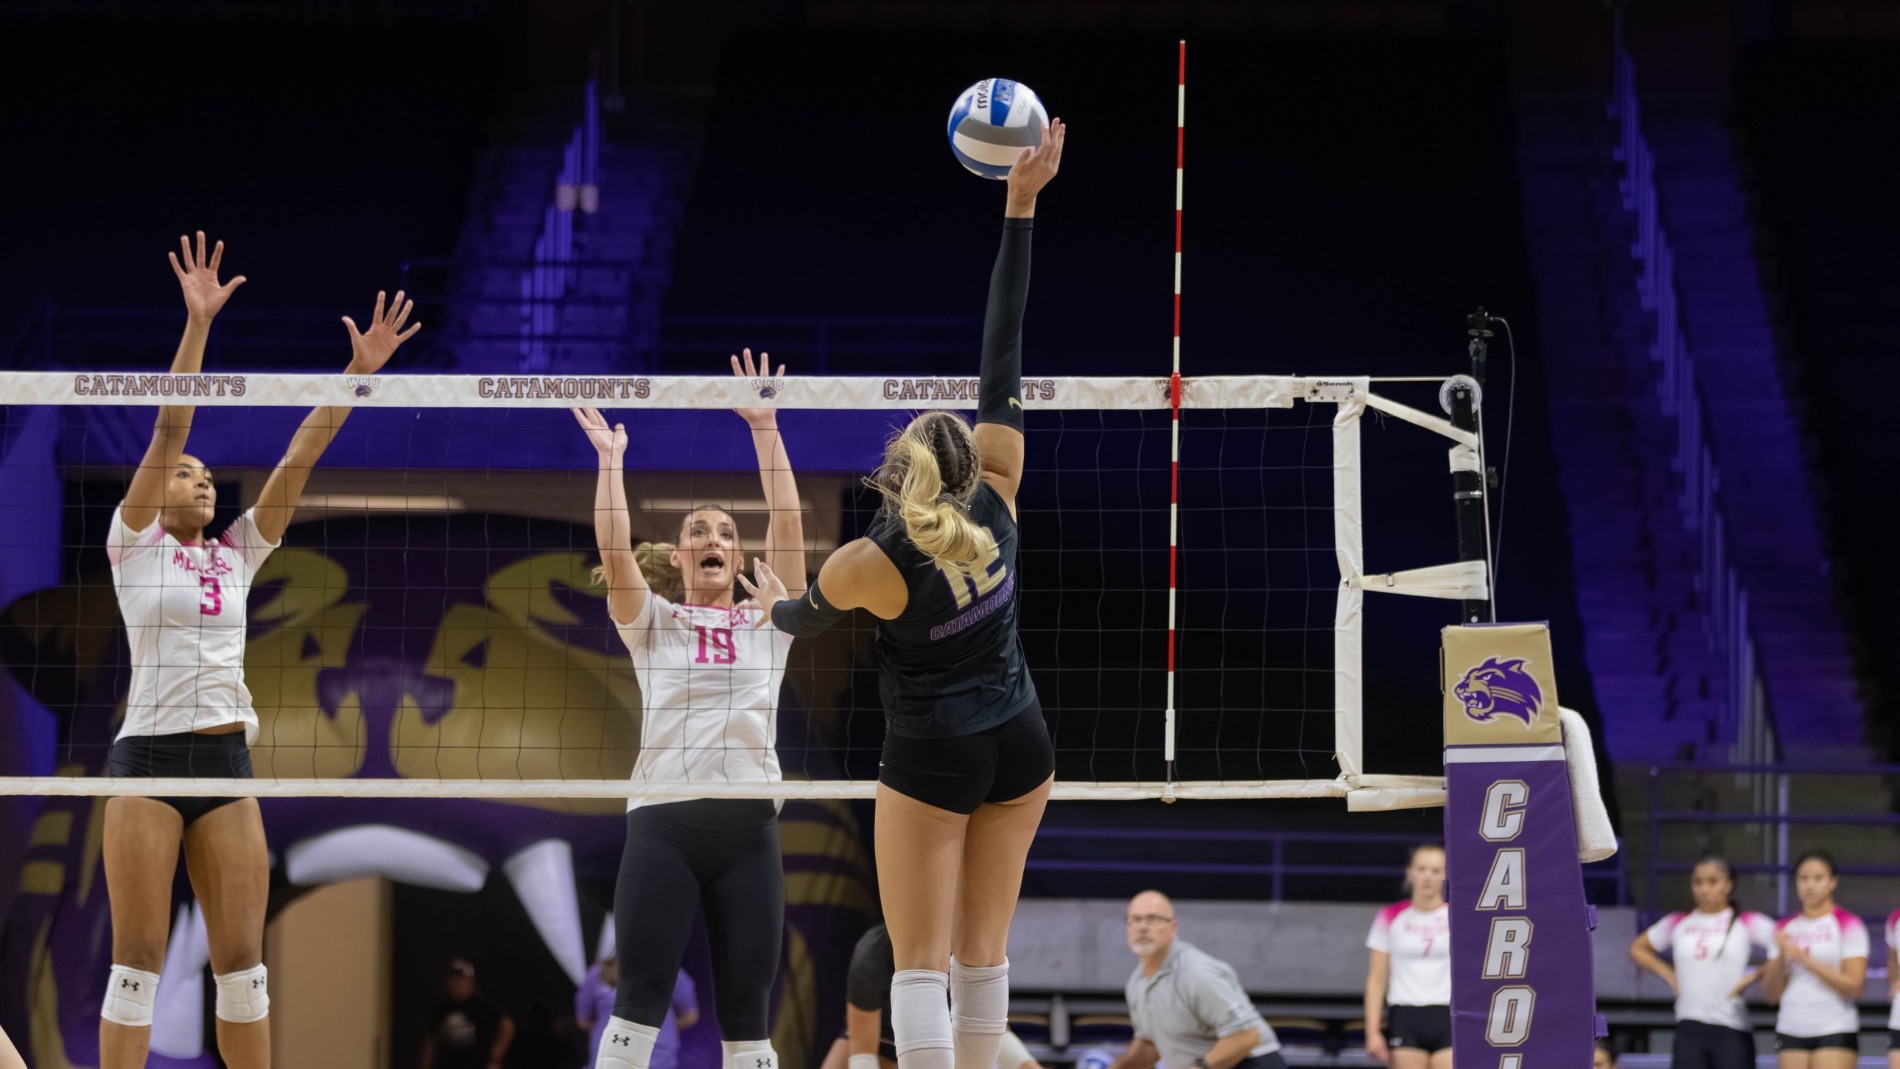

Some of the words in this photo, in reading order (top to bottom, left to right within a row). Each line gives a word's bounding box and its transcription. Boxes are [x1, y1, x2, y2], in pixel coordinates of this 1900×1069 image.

[74, 375, 246, 396] CATAMOUNTS
[346, 376, 380, 389] WCU
[478, 378, 651, 399] CATAMOUNTS
[750, 377, 784, 391] WCU
[883, 379, 1055, 400] CATAMOTS
[1155, 379, 1190, 391] WU
[199, 575, 222, 616] 3
[694, 625, 737, 665] 19
[1475, 779, 1537, 1069] CARO
